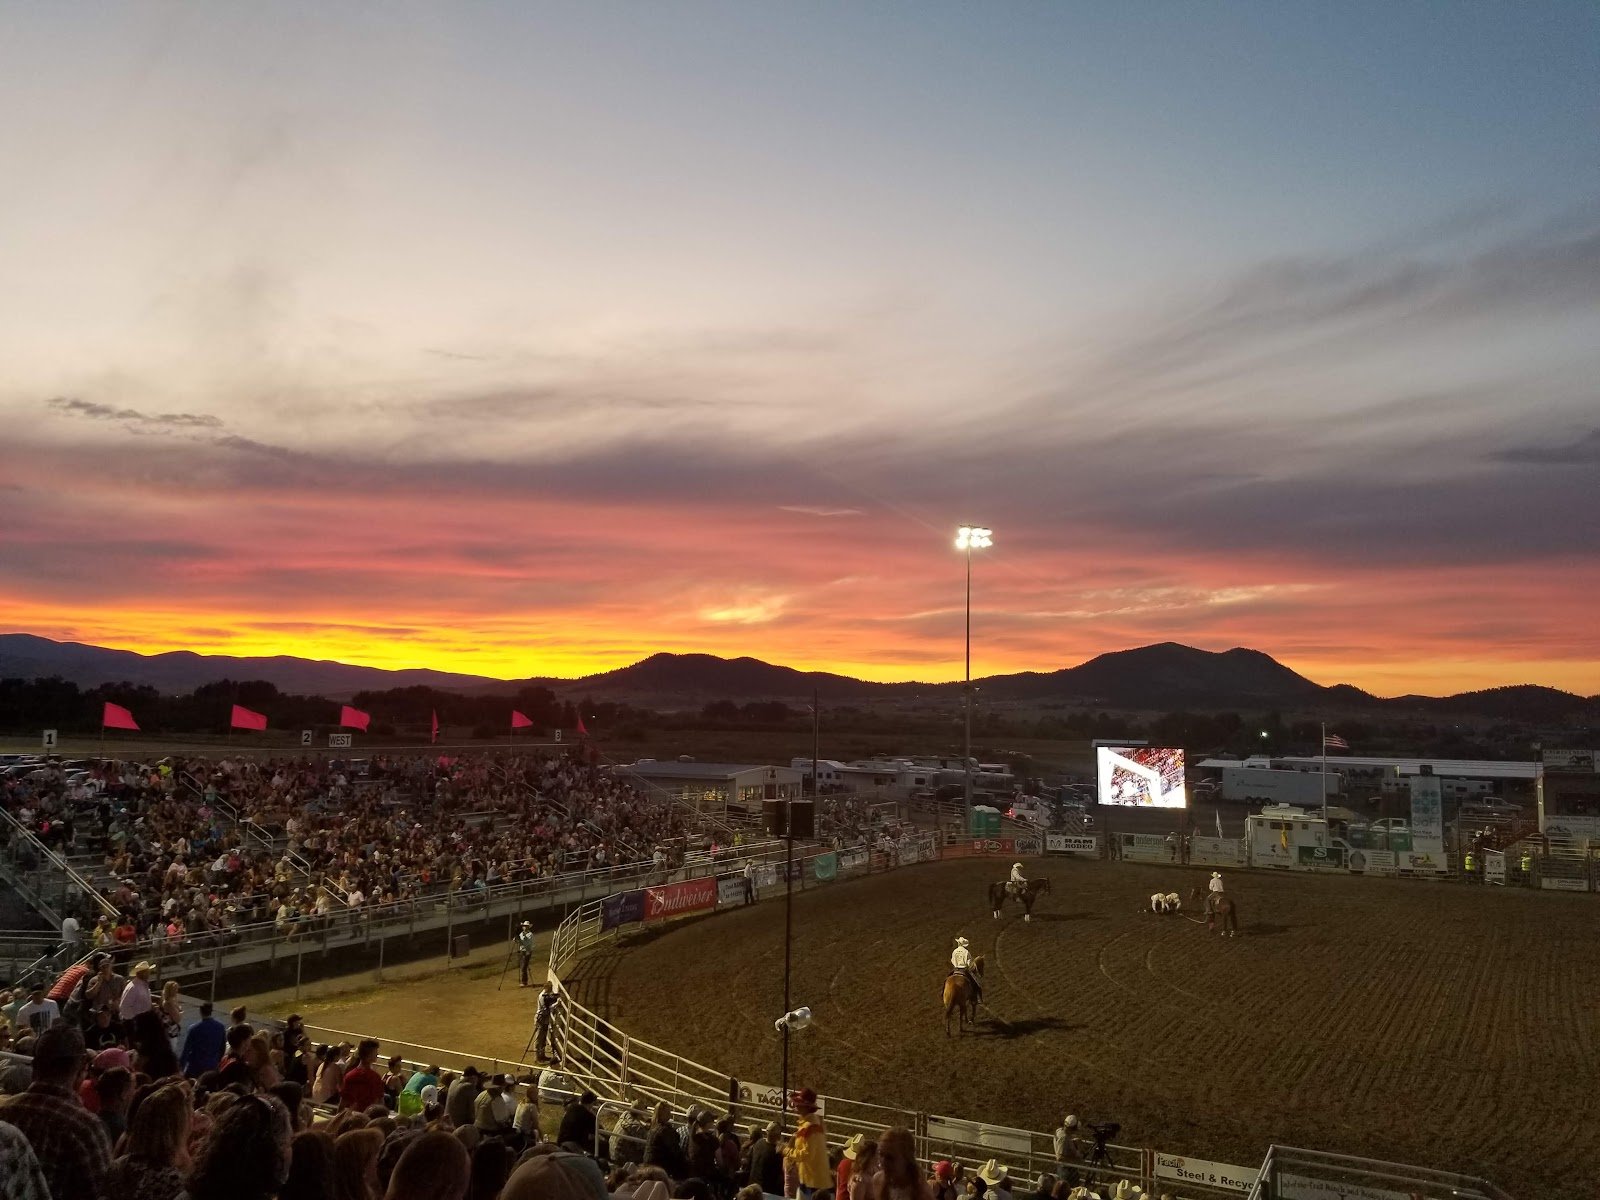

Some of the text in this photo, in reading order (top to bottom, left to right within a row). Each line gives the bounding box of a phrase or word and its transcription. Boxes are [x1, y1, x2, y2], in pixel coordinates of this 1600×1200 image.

[303, 733, 310, 743] 2
[329, 735, 350, 745] WEST
[649, 887, 714, 915] Budweiser
[756, 1092, 783, 1107] TACO
[1176, 1168, 1255, 1190] Steel & Recyc
